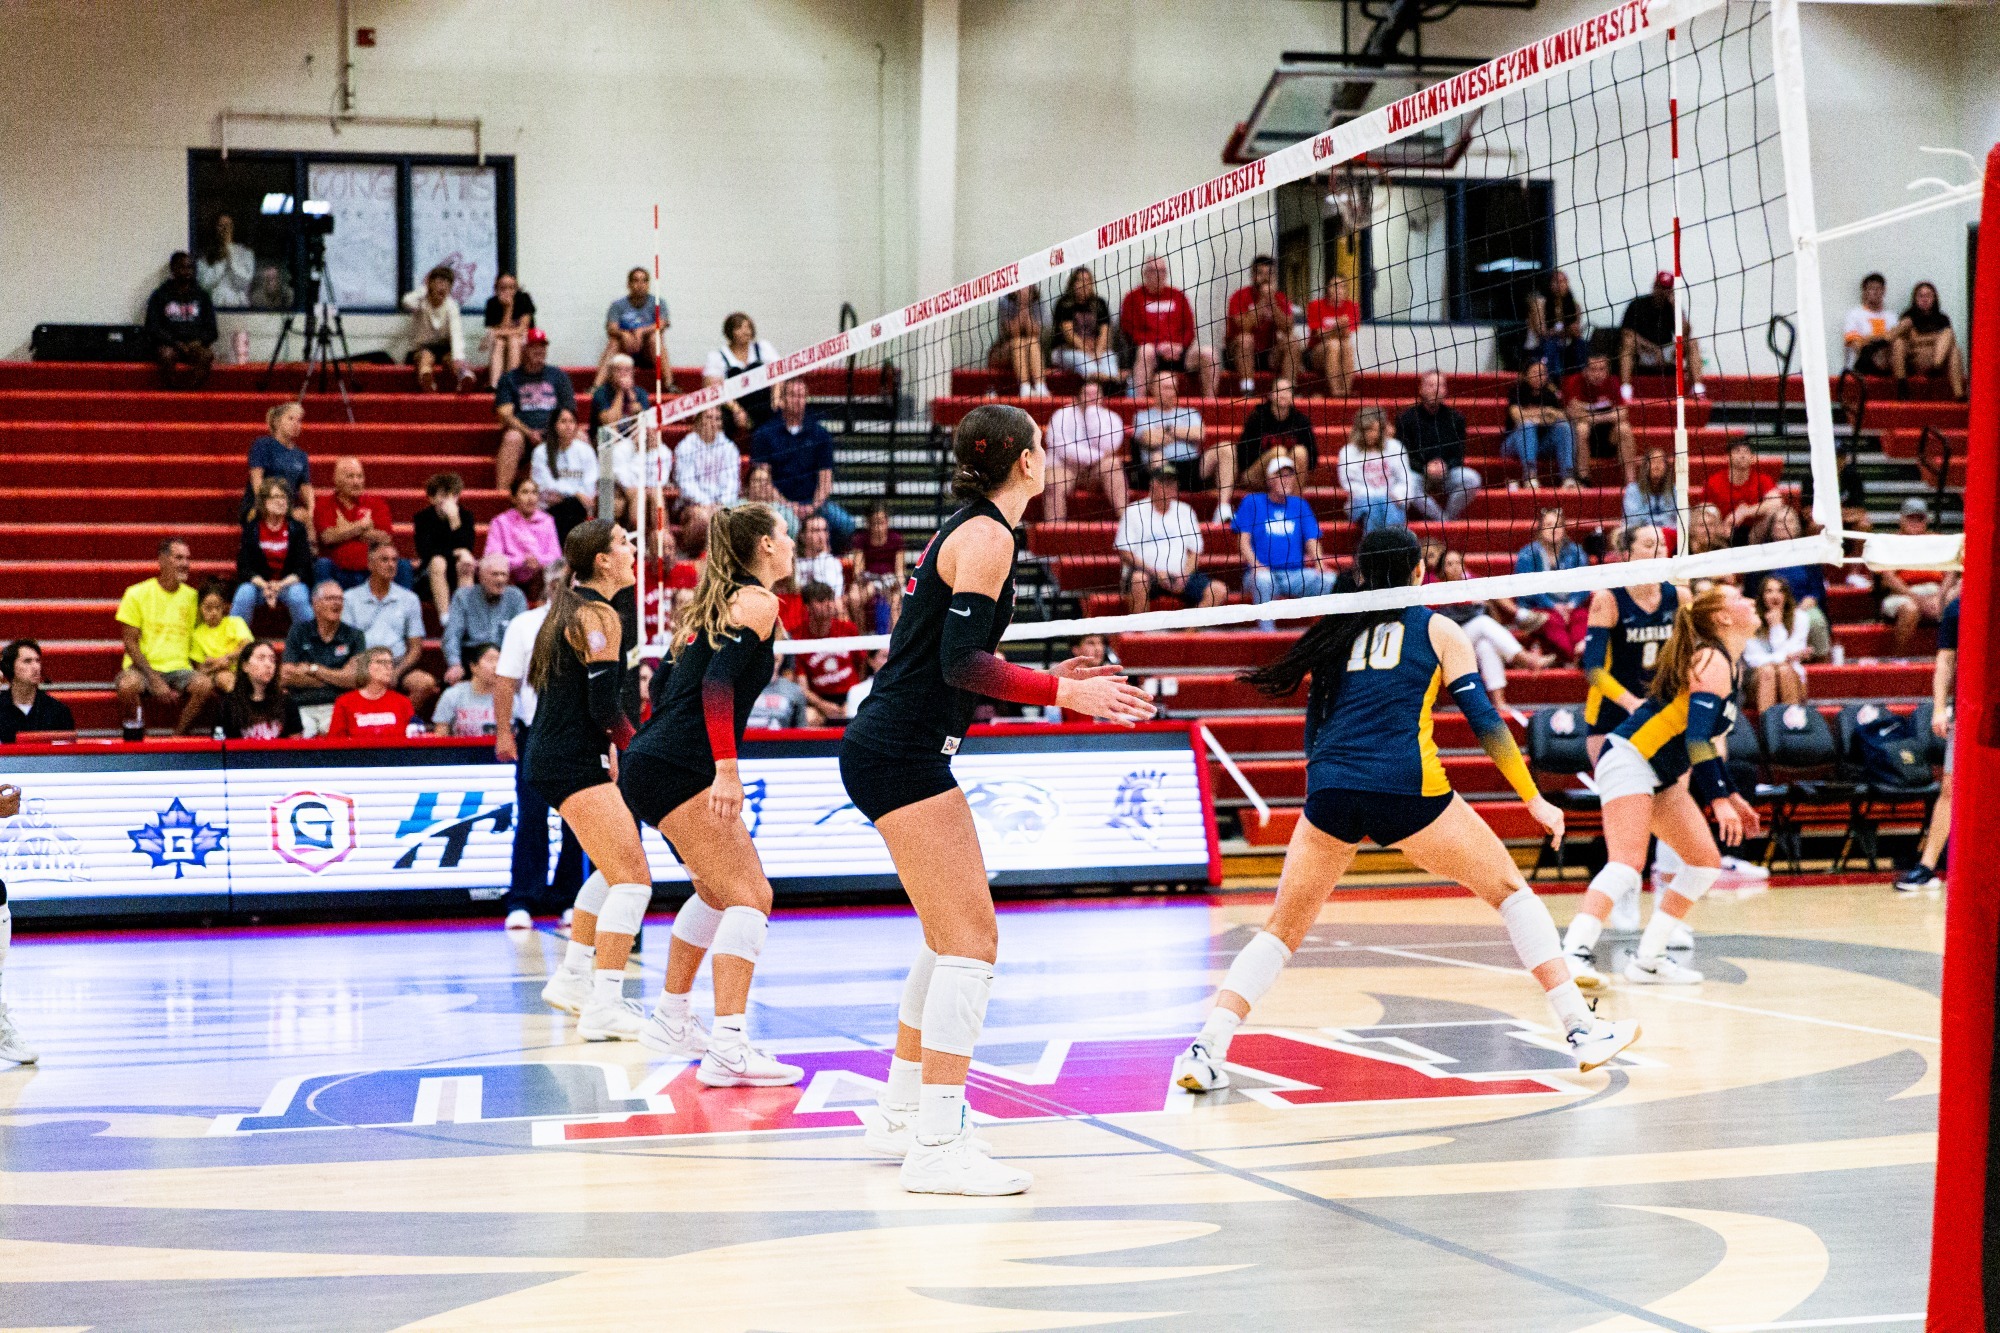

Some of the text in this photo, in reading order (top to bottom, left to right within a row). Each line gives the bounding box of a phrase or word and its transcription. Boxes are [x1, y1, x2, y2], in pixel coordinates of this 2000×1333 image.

[1386, 0, 1650, 133] INDIANA WESLEYAN UNIVERSITY
[1097, 159, 1266, 249] INDIANA WESLEYAN UNIVERSITY
[973, 262, 1019, 300] UNIVERSITY
[1346, 620, 1405, 672] 10
